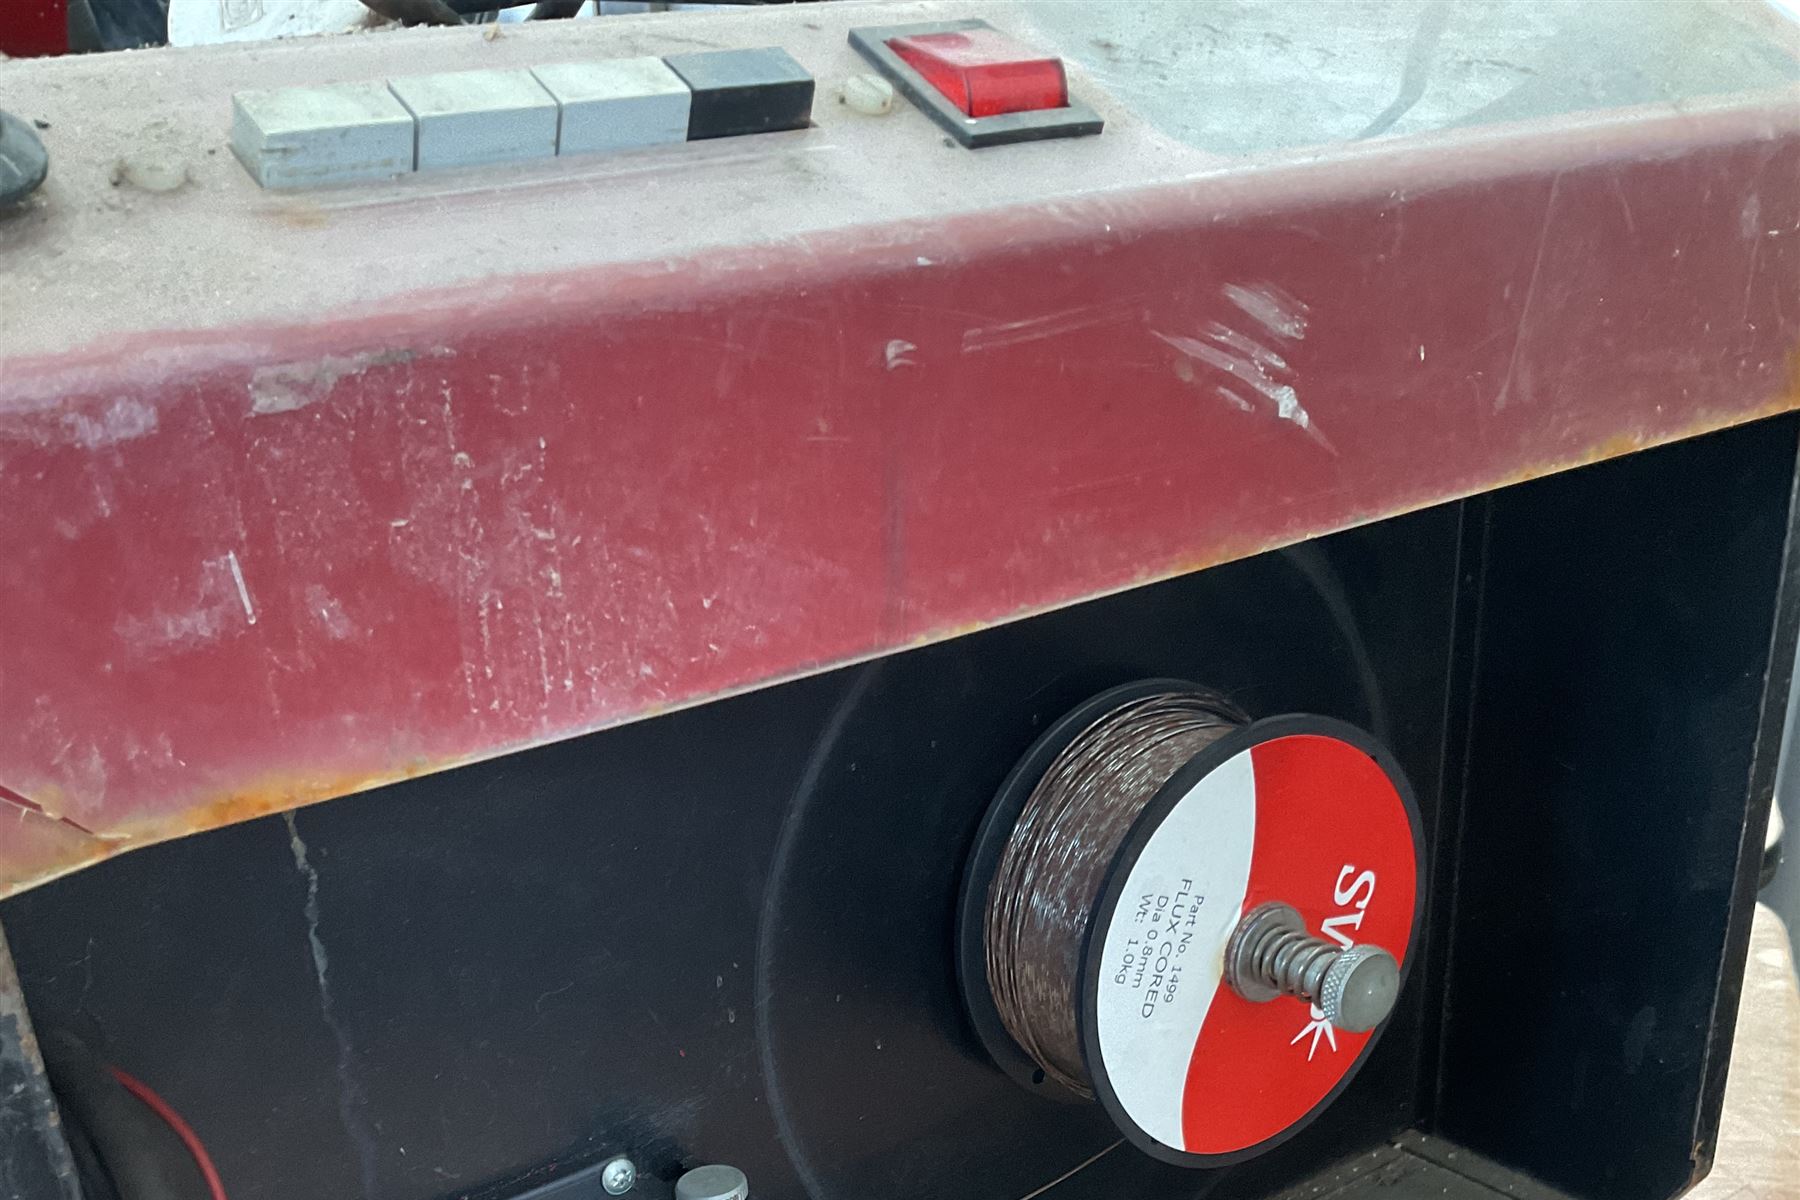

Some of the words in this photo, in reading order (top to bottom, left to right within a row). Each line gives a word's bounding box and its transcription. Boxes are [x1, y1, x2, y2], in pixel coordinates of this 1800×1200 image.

[1134, 893, 1154, 924] Wt:
[1151, 895, 1169, 923] Dia
[1166, 878, 1193, 935] FLUX
[1189, 895, 1205, 927] Part
[1114, 938, 1139, 985] 1.0kg
[1131, 930, 1158, 989] 0.8mm
[1175, 932, 1193, 958] No.
[1141, 941, 1173, 1019] CORED
[1163, 966, 1182, 1003] 1499
